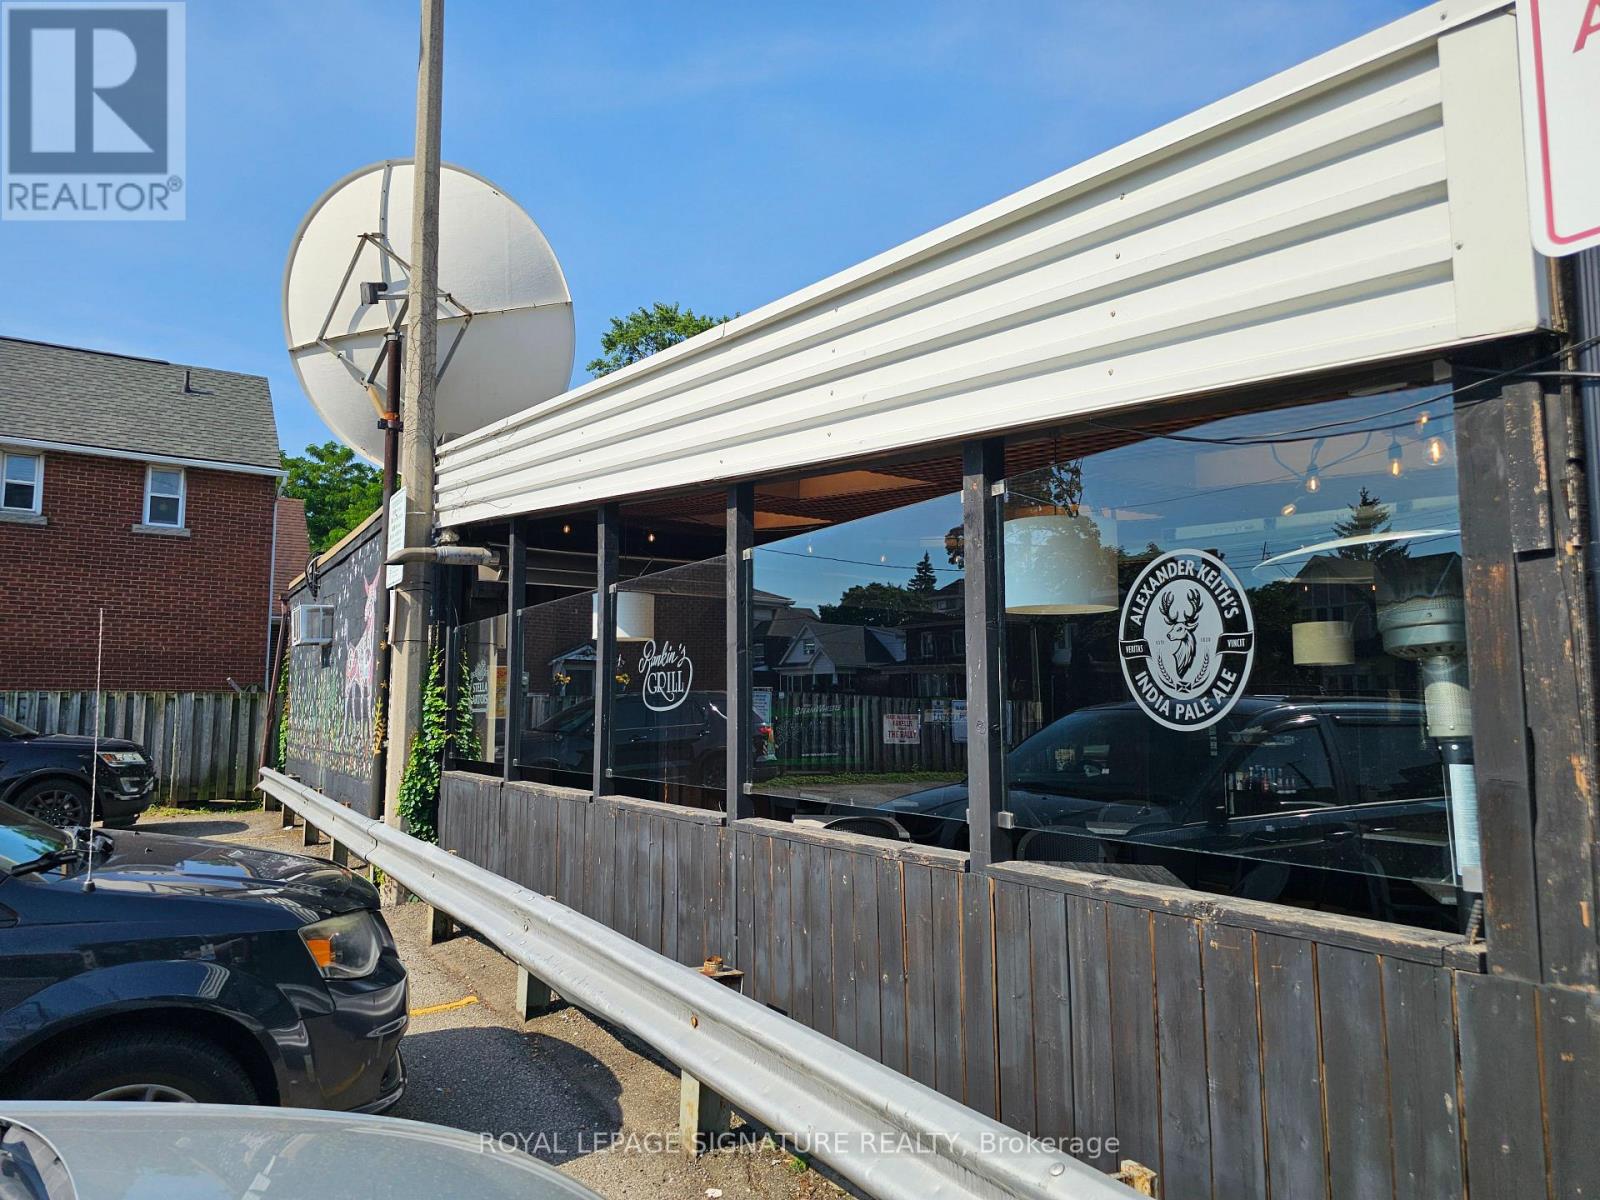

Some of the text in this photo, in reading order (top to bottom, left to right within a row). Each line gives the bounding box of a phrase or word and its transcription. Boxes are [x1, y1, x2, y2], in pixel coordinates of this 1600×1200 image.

[1130, 559, 1240, 627] ALEXANDER KEITH'S
[472, 681, 488, 693] STELLA
[647, 670, 684, 701] GRILL
[1134, 668, 1238, 721] INDIA PALE ALE
